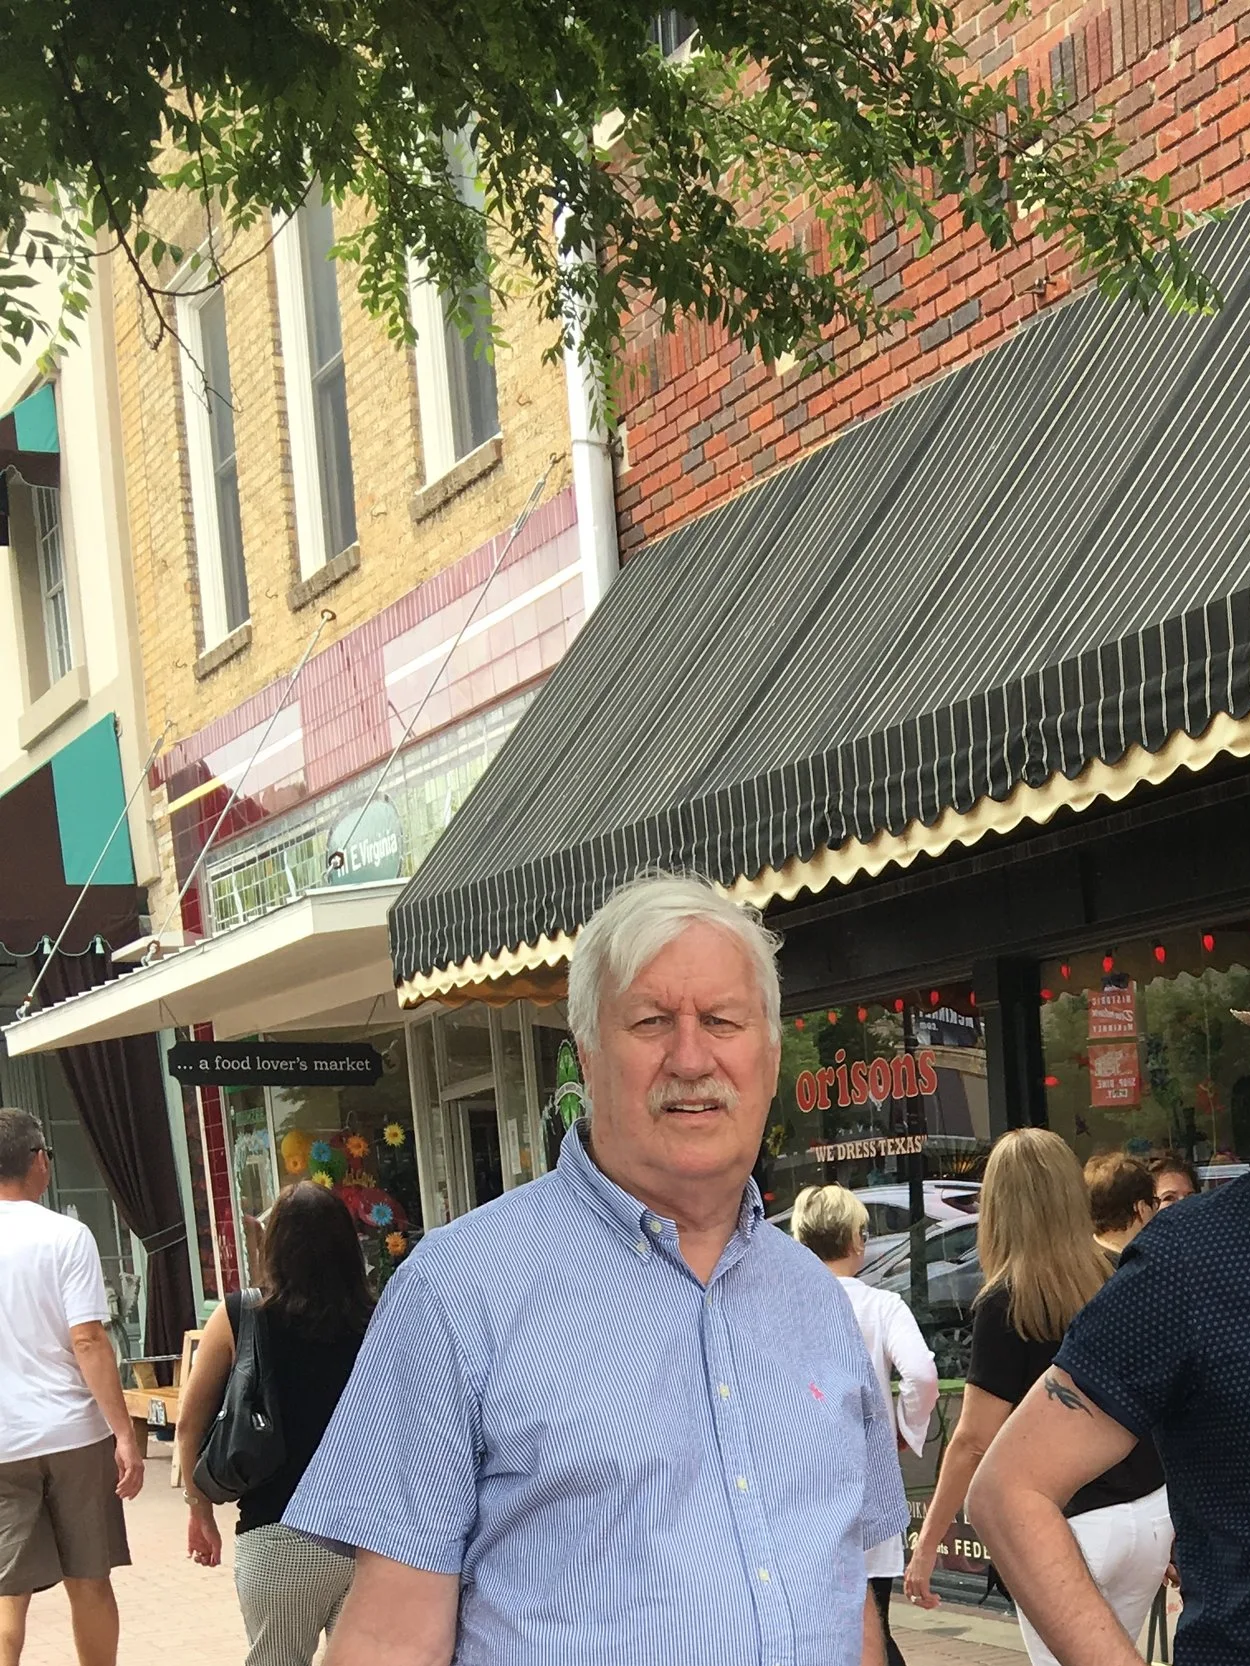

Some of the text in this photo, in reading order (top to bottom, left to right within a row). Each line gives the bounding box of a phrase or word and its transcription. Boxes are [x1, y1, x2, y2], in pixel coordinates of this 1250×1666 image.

[359, 829, 398, 867] Virginia
[199, 1060, 210, 1070] a
[214, 1055, 252, 1071] food
[256, 1056, 308, 1072] lover's
[313, 1057, 372, 1072] market
[796, 1048, 938, 1113] orisons
[837, 1139, 877, 1162] DRESS
